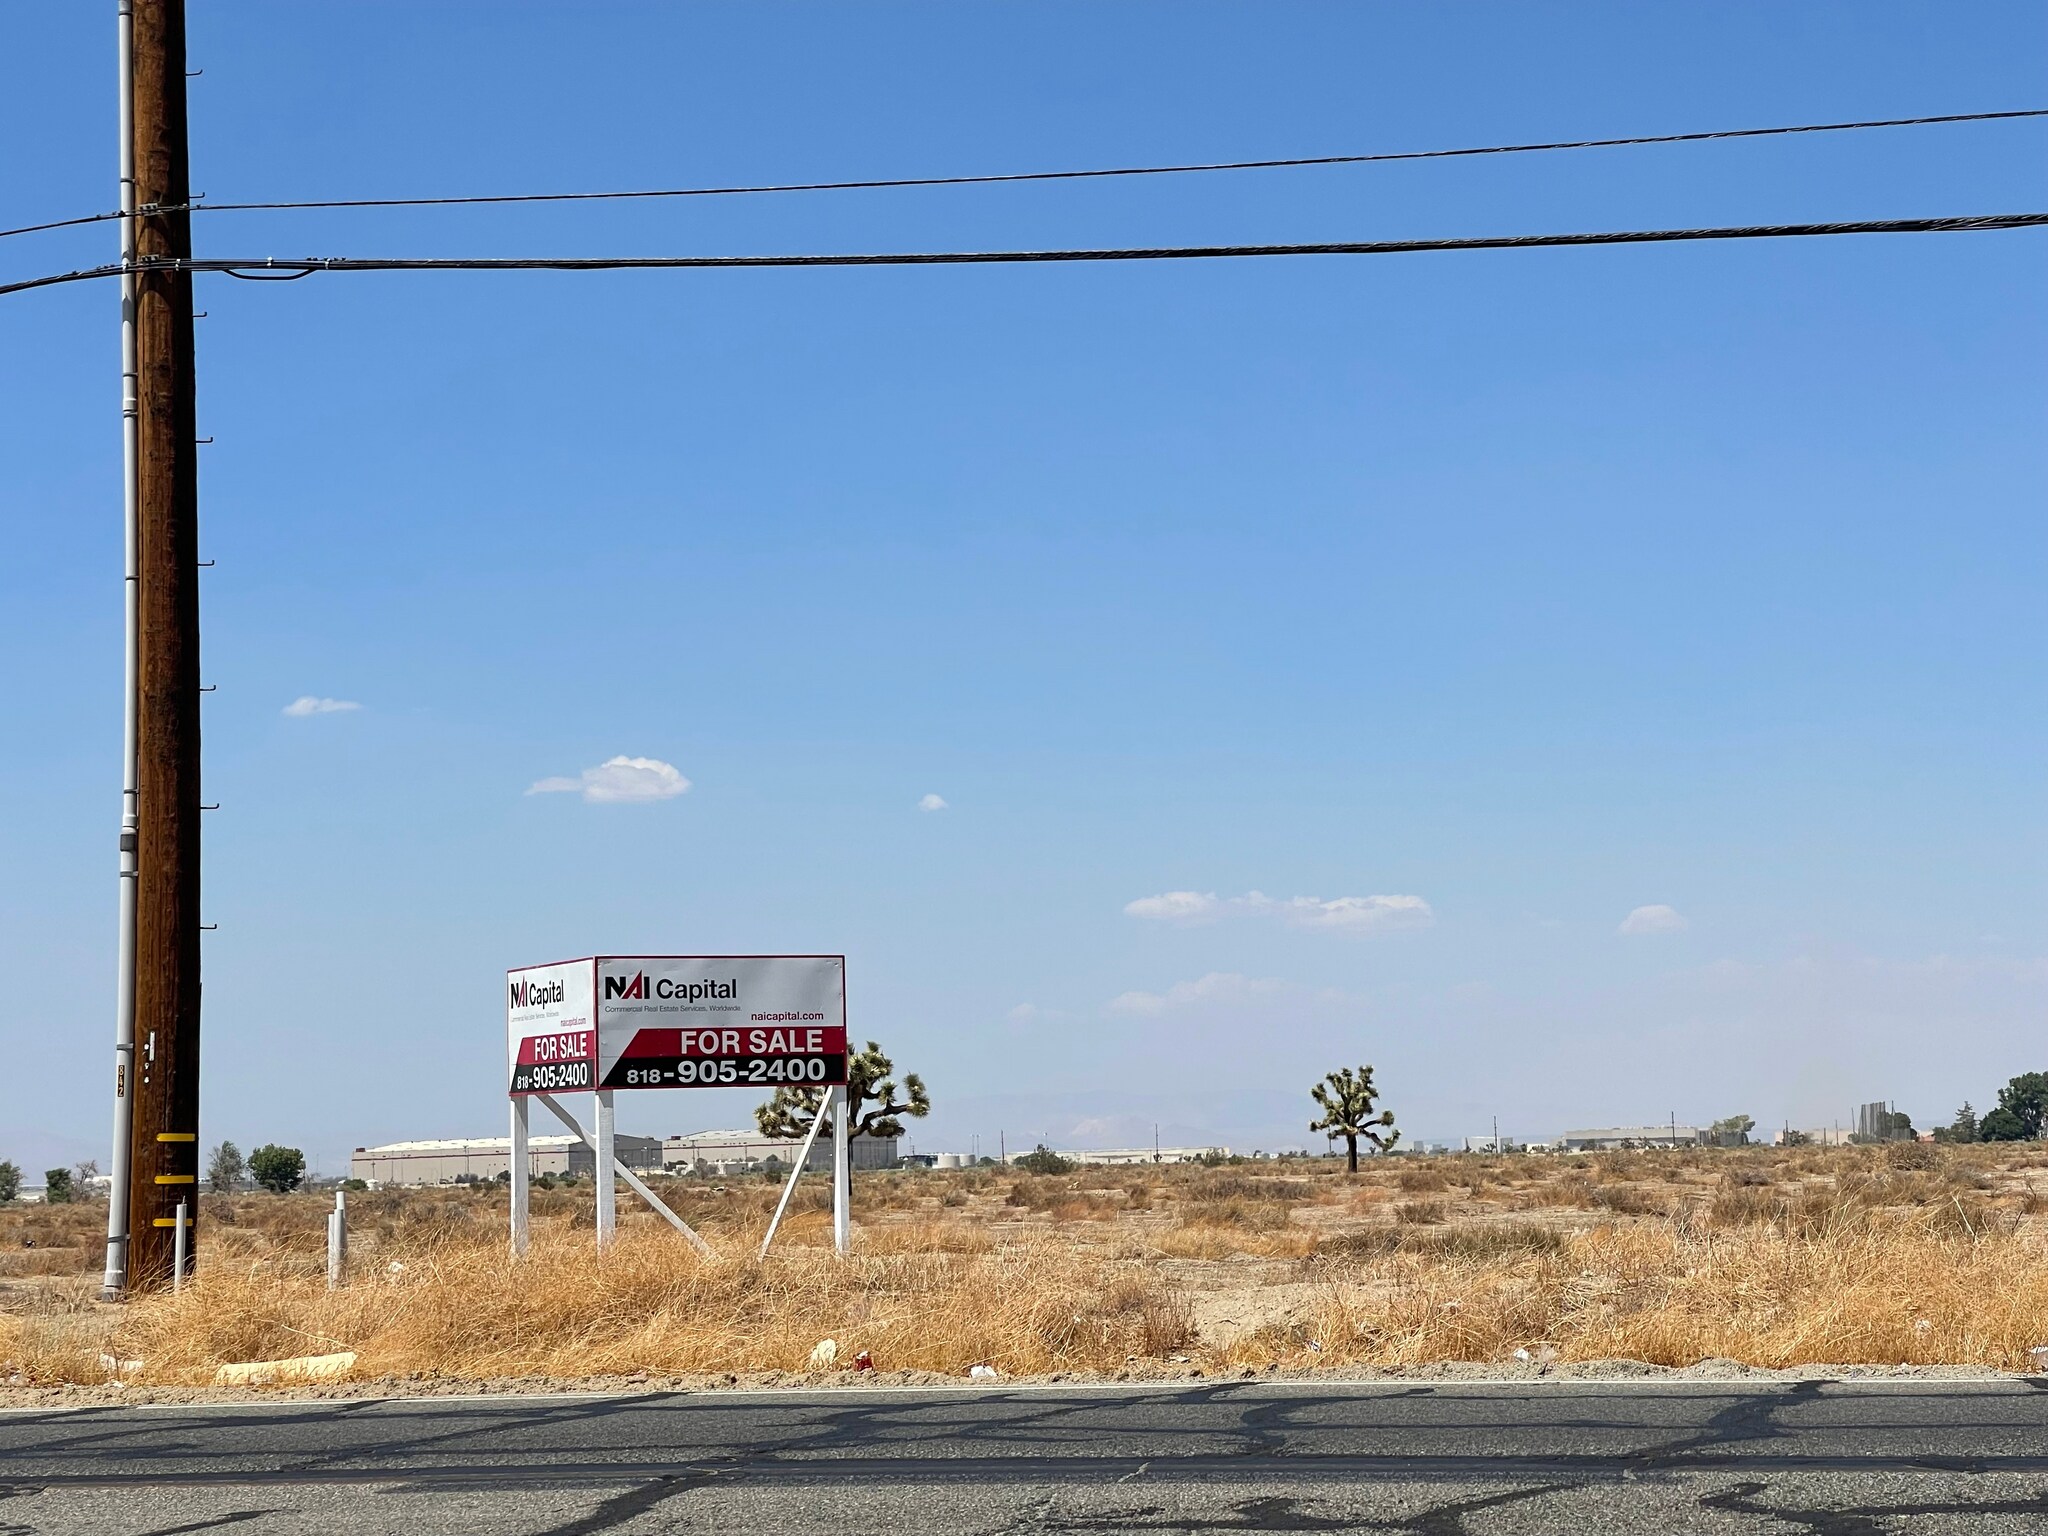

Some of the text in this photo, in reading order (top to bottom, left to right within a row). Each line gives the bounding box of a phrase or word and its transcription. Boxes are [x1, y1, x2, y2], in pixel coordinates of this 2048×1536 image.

[510, 975, 564, 1010] NAI Capital
[604, 969, 737, 1004] NAI Capital
[604, 1005, 643, 1013] Commercial
[751, 1011, 824, 1022] naicapital.com
[534, 1033, 588, 1061] FOR SALE
[681, 1029, 824, 1055] FOR SALE
[516, 1062, 588, 1090] 818-905-2400
[626, 1058, 826, 1084] 818-905-2400
